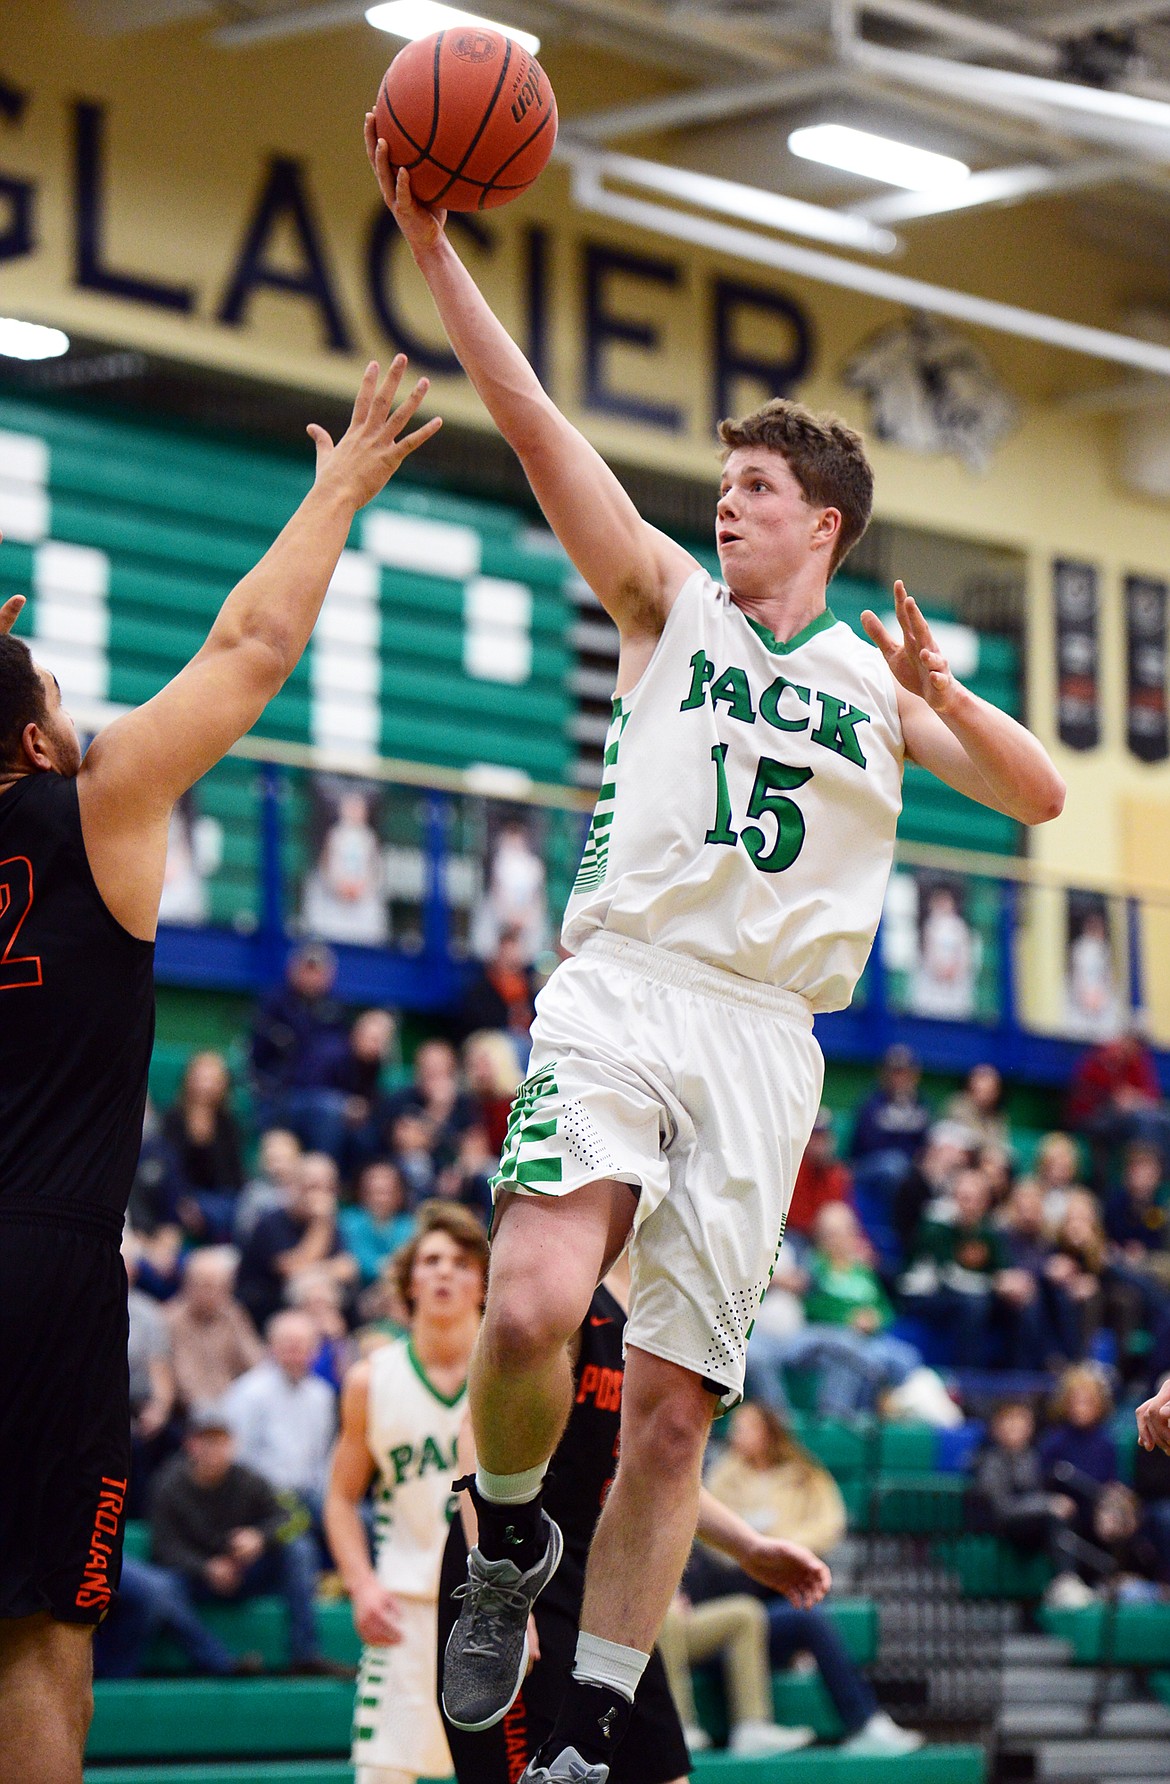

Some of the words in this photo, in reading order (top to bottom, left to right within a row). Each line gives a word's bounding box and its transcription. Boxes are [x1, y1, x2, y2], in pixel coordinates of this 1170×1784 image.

[510, 54, 543, 124] den
[679, 649, 872, 770] PACK
[704, 742, 816, 874] 15
[576, 1362, 624, 1412] POS
[390, 1436, 459, 1484] PA
[75, 1476, 127, 1610] TROJANS
[503, 1689, 528, 1784] OJAN
